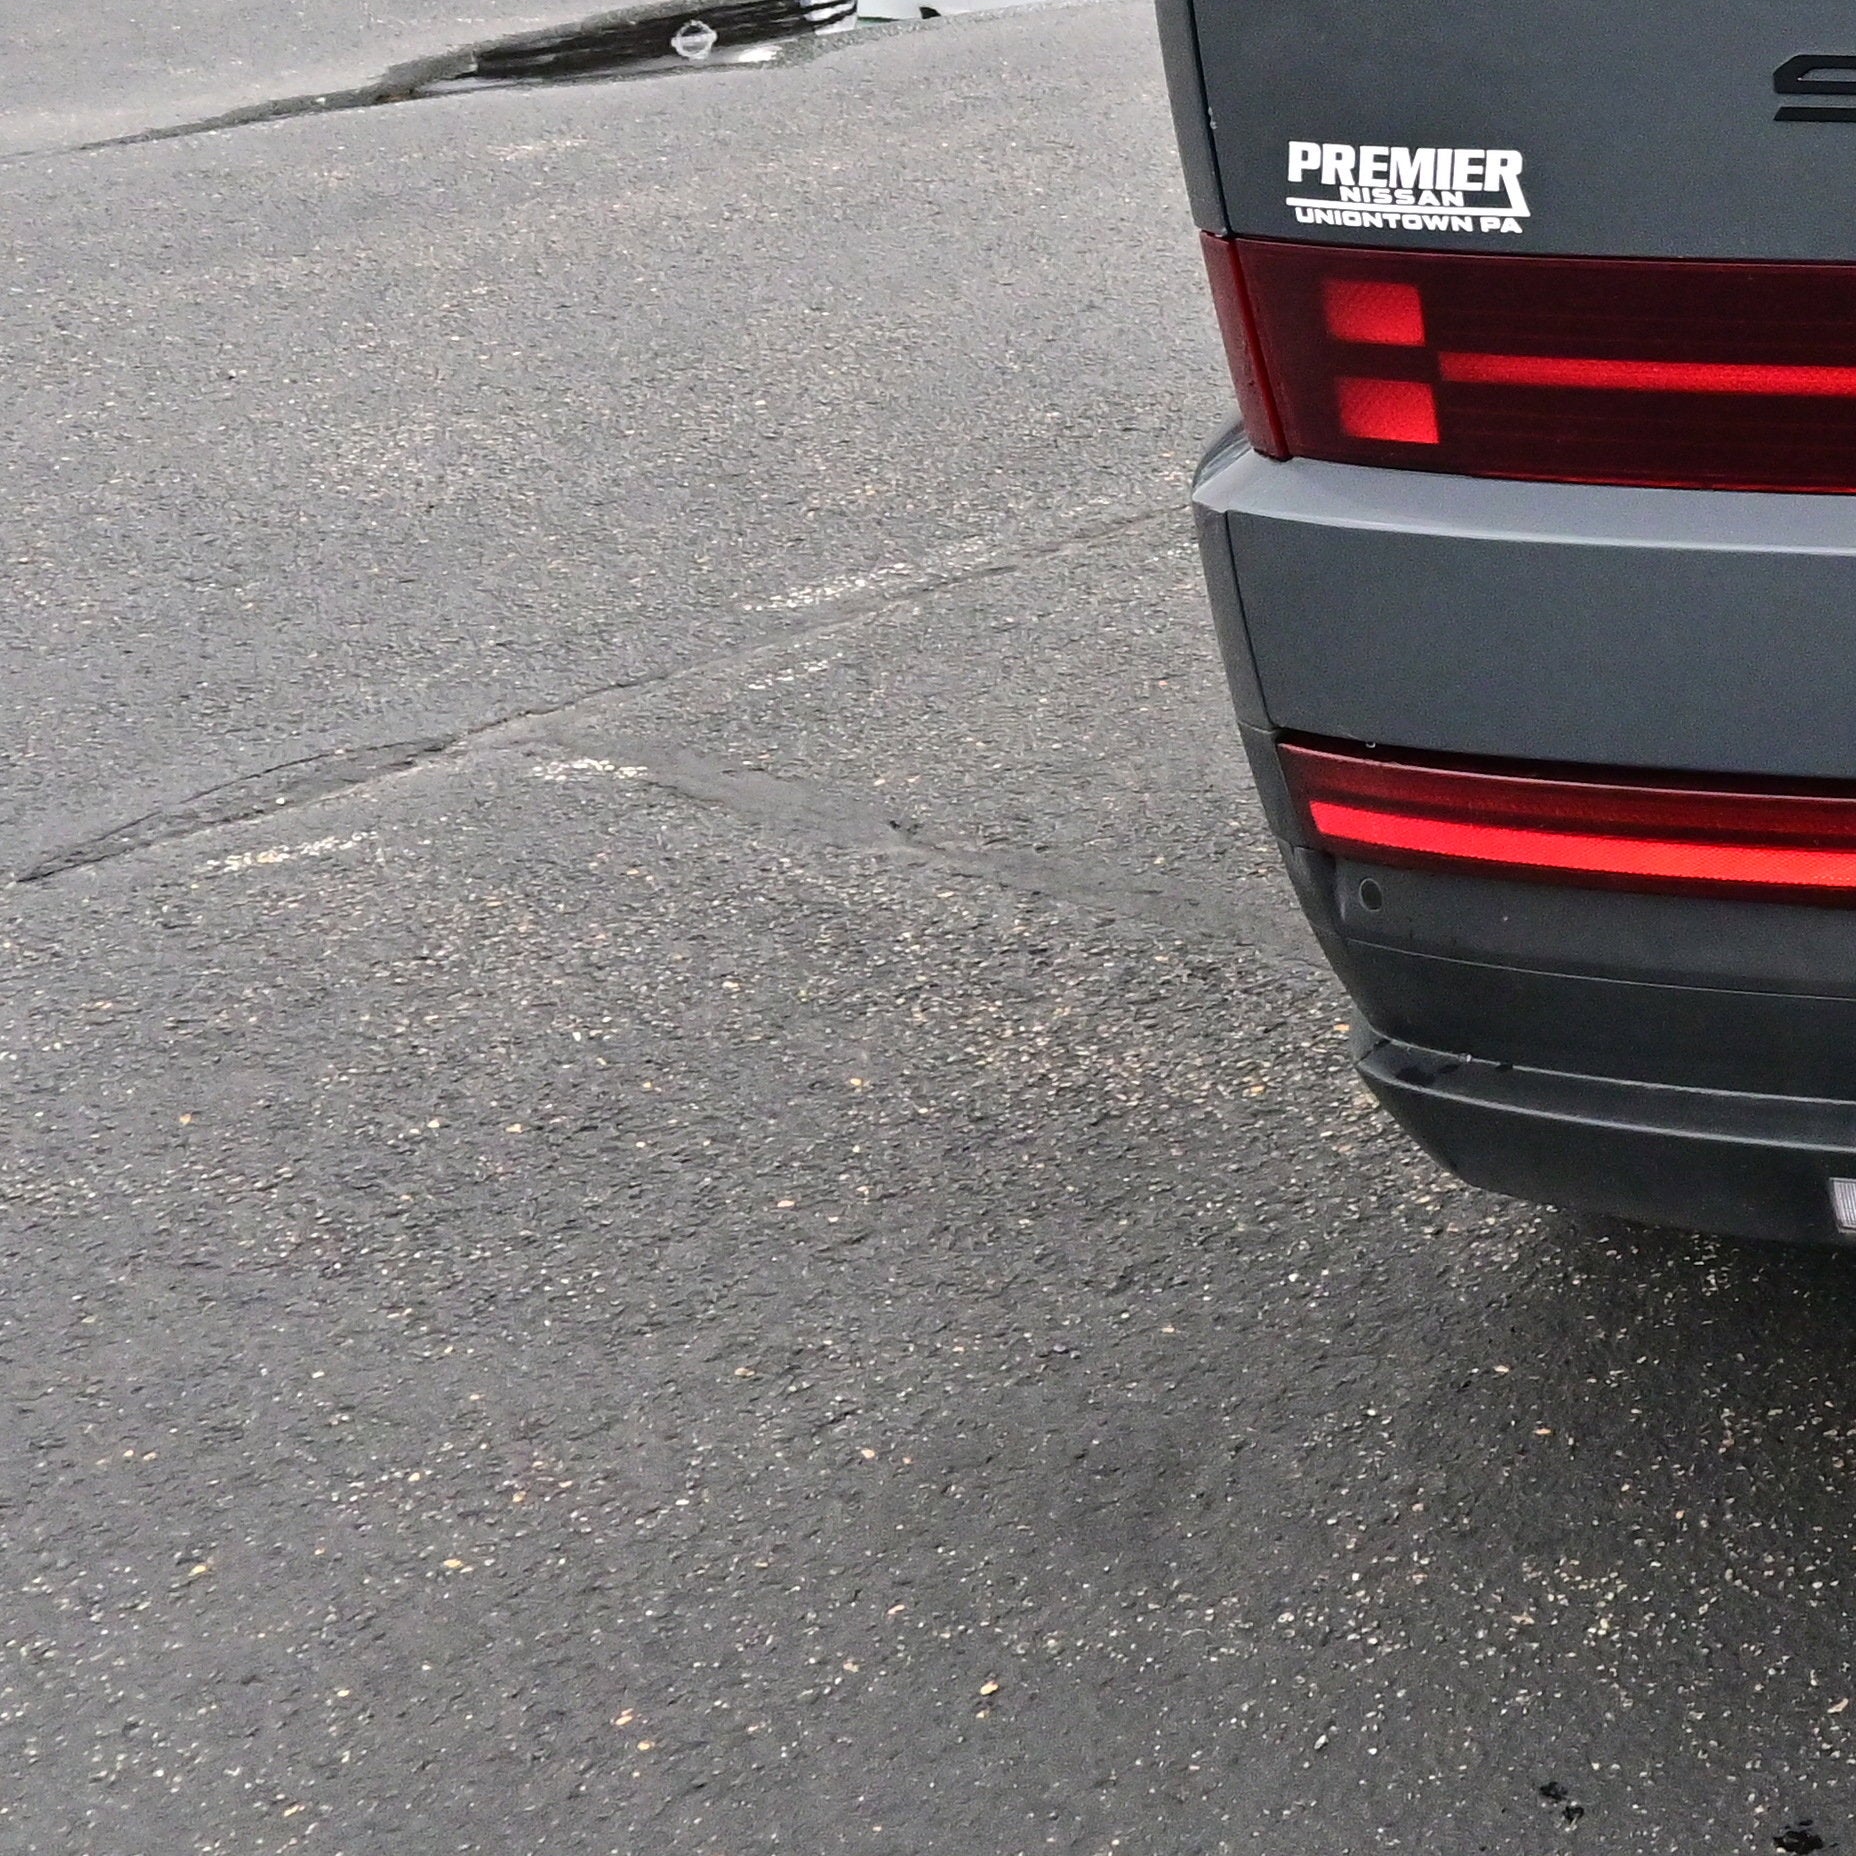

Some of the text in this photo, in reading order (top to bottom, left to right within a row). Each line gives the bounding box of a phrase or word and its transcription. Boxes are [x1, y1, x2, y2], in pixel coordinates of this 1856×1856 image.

[1287, 141, 1528, 201] PREMIER
[1339, 186, 1465, 207] NISSAN
[1295, 207, 1524, 234] UNIONTOWN PA
